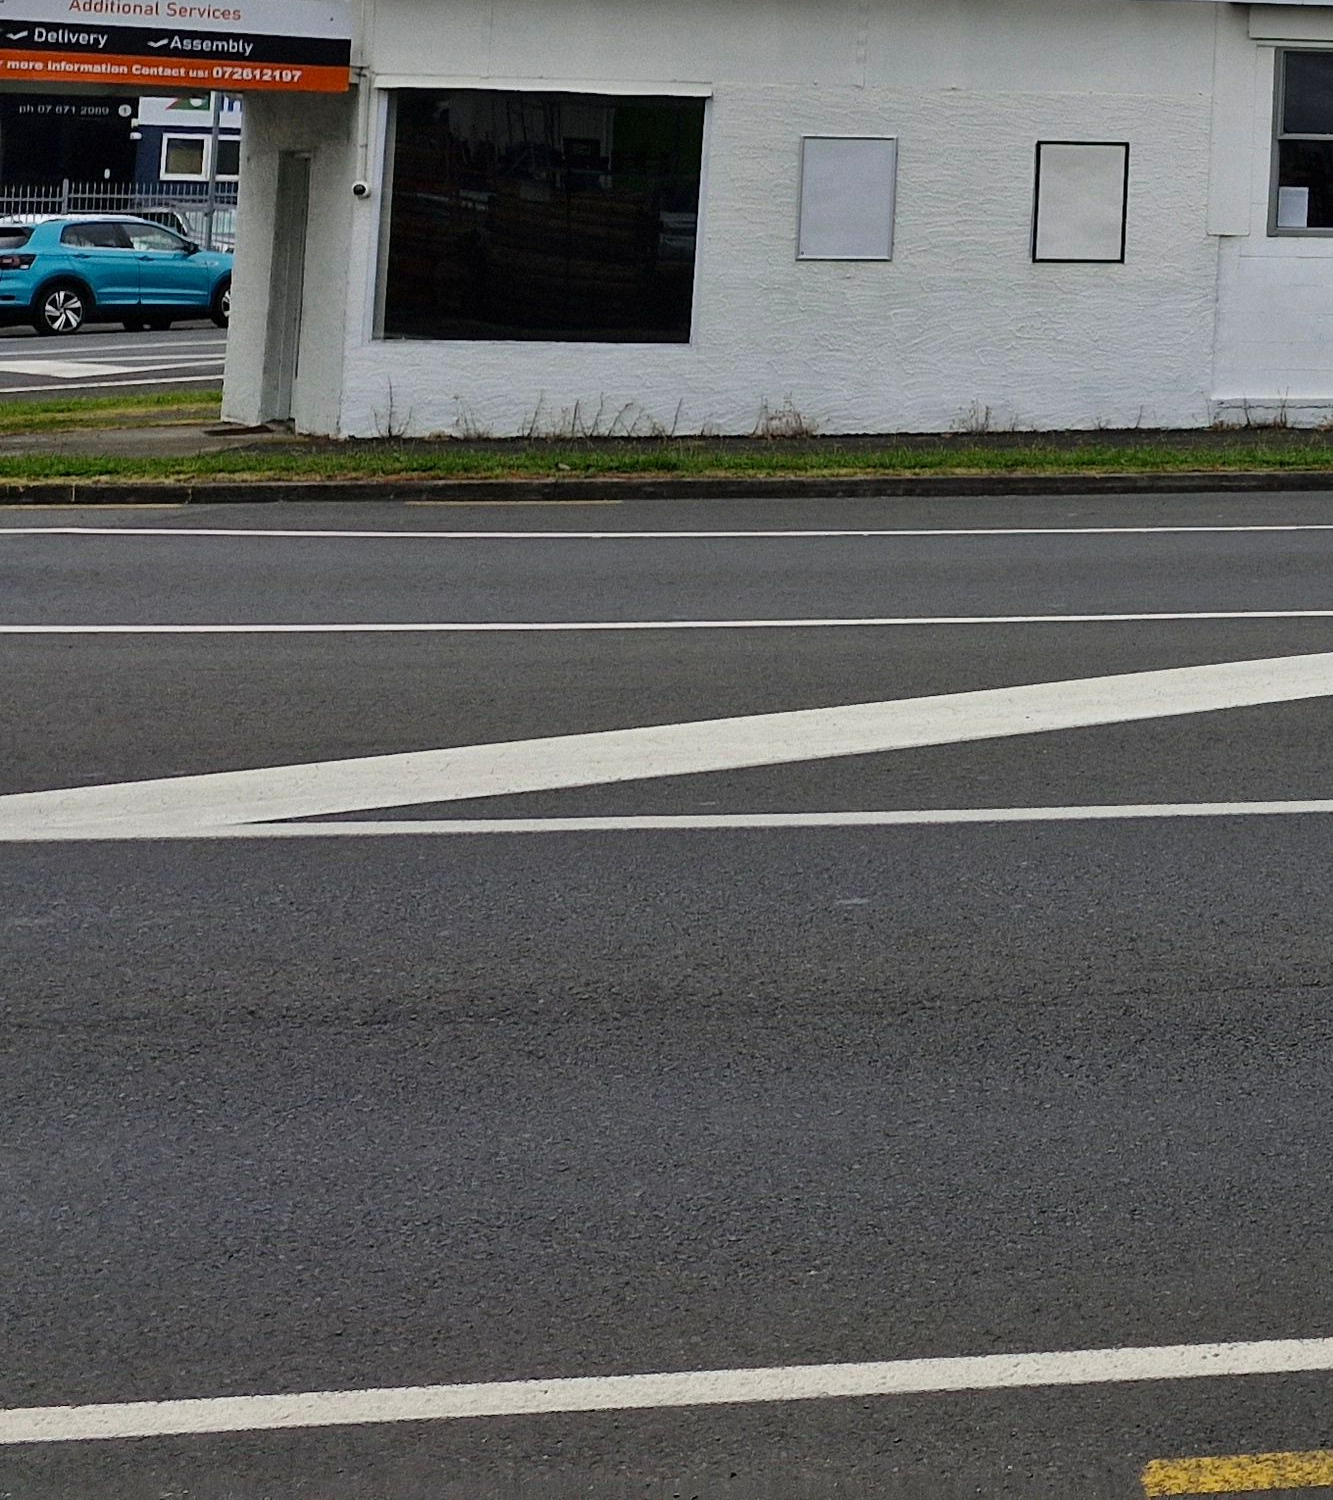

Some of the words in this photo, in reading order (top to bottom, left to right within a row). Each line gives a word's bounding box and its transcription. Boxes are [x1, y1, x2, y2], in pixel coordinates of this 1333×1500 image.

[166, 2, 242, 22] Services
[34, 27, 109, 48] Delivery
[169, 35, 254, 57] Assembly
[7, 59, 44, 71] more
[132, 64, 185, 77] Contact
